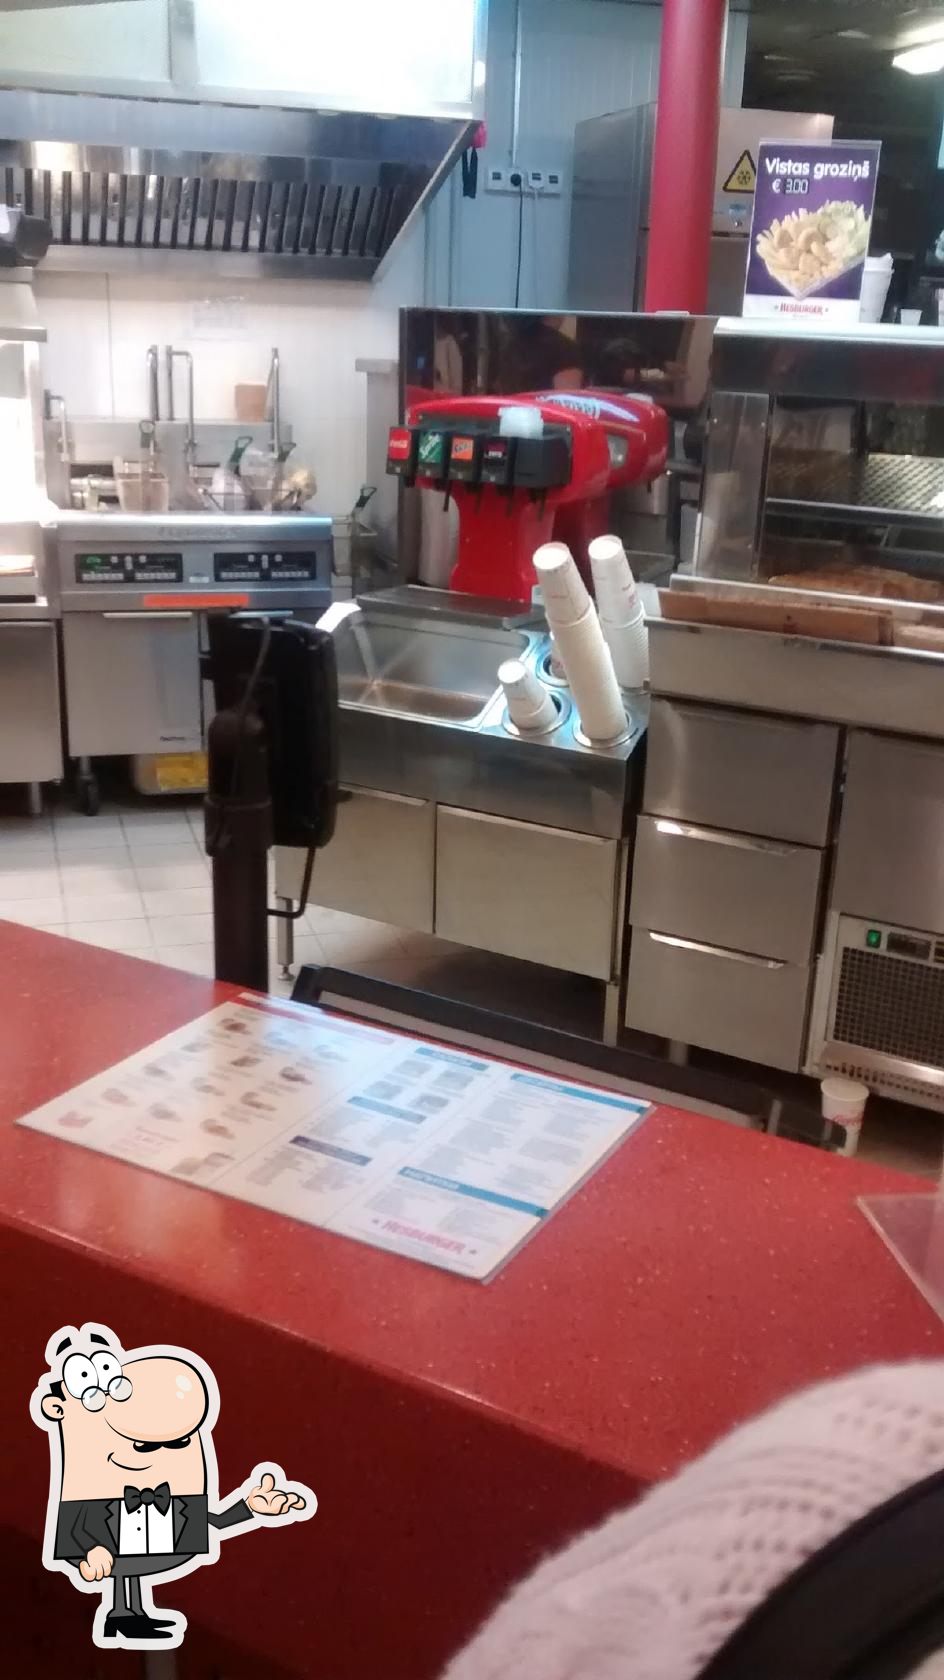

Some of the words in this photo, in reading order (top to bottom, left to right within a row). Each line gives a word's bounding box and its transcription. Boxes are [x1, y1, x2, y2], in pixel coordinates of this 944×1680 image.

[765, 157, 810, 176] Vistas
[813, 160, 870, 182] groziņš
[772, 178, 782, 194] €
